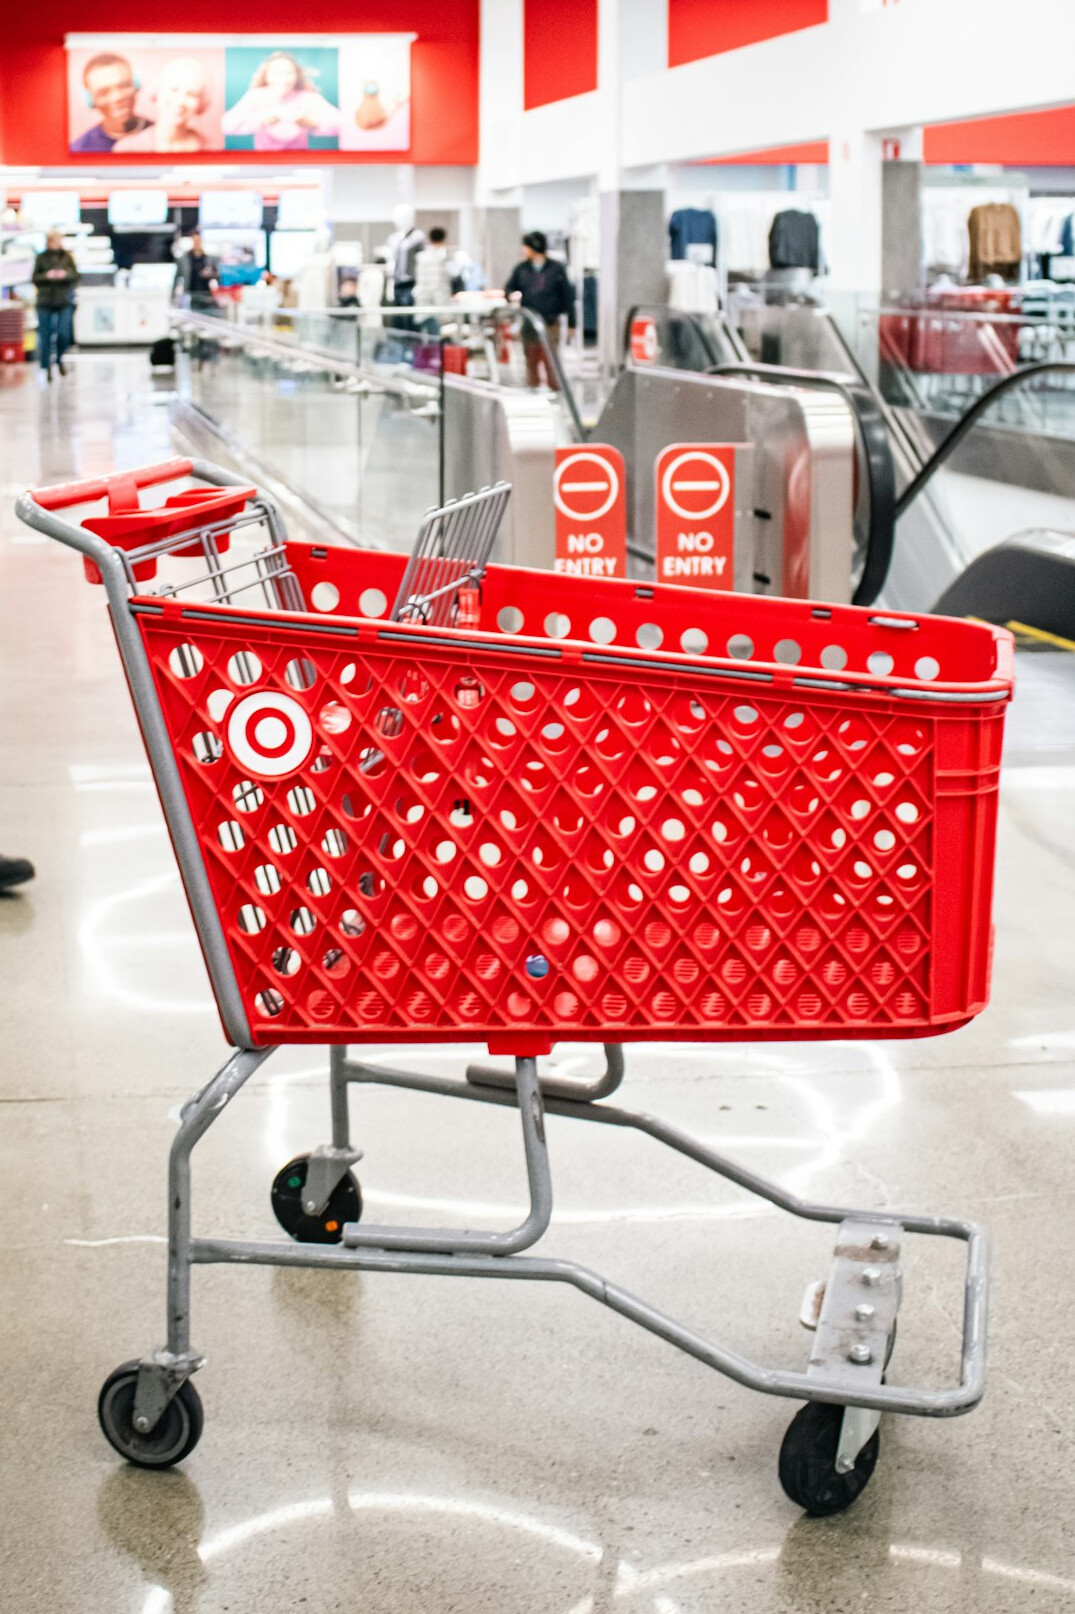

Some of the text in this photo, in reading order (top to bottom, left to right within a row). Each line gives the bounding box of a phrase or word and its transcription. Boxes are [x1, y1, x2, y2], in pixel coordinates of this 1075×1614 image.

[567, 532, 604, 553] NO
[677, 531, 714, 552] NO
[554, 556, 617, 576] ENTRY
[663, 556, 726, 577] ENTRY
